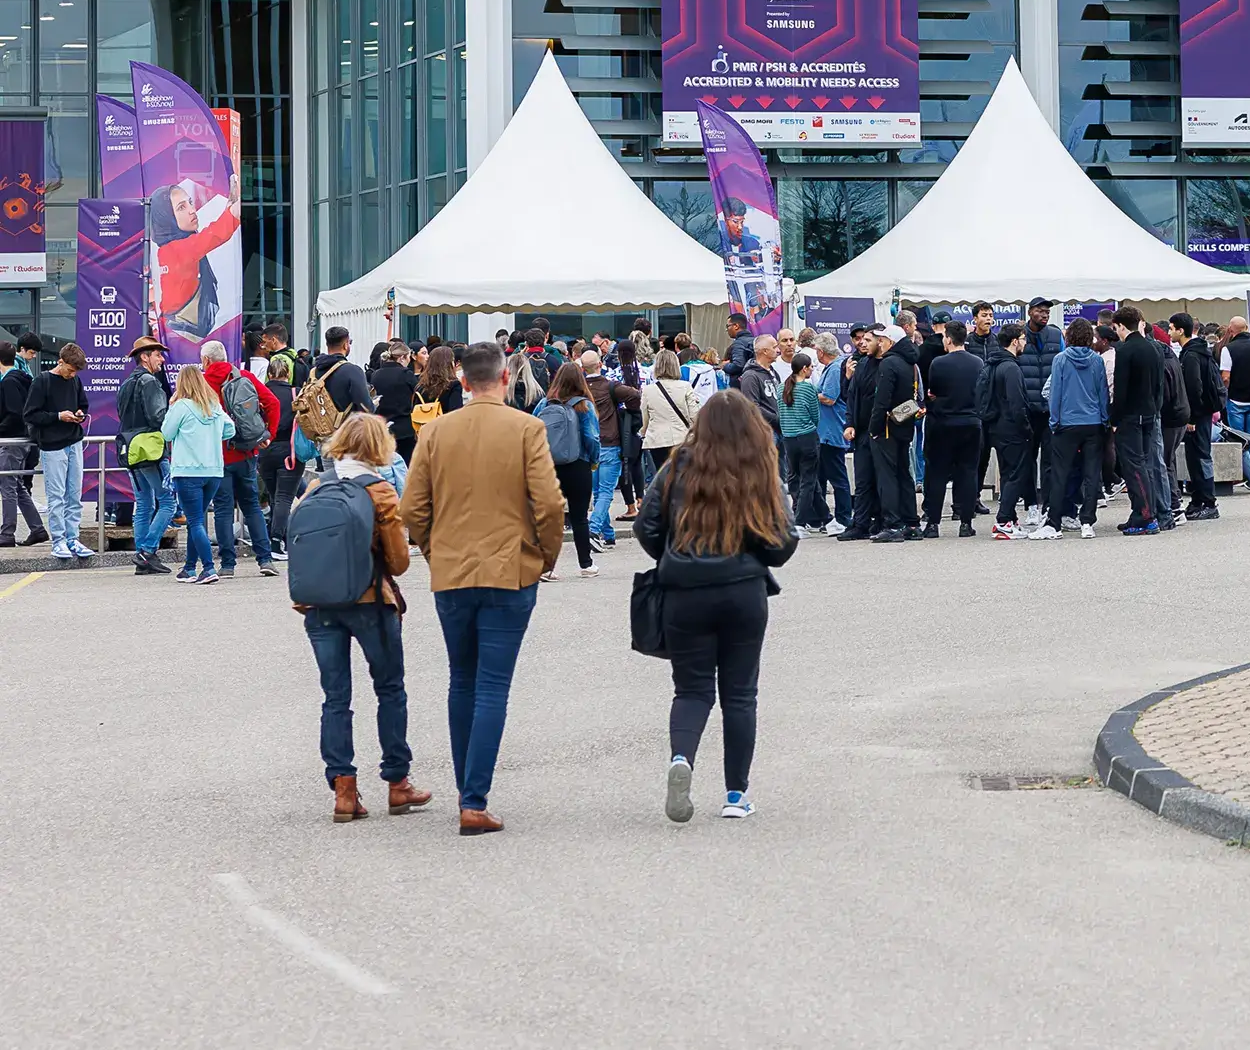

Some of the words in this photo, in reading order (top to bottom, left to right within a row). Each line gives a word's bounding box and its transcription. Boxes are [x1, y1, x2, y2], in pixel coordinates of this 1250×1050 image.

[766, 20, 815, 28] SAMSUNG
[733, 62, 756, 72] PMR
[766, 62, 787, 72] PSH
[789, 62, 798, 72] &
[800, 60, 866, 73] ACCREDITÉS
[683, 77, 752, 87] ACCREDITED
[755, 77, 763, 87] &
[766, 77, 818, 88] MOBILITY
[820, 78, 856, 88] NEEDS
[858, 78, 899, 88] ACCESS
[1188, 243, 1217, 251] SKILLS
[94, 334, 120, 347] BUS
